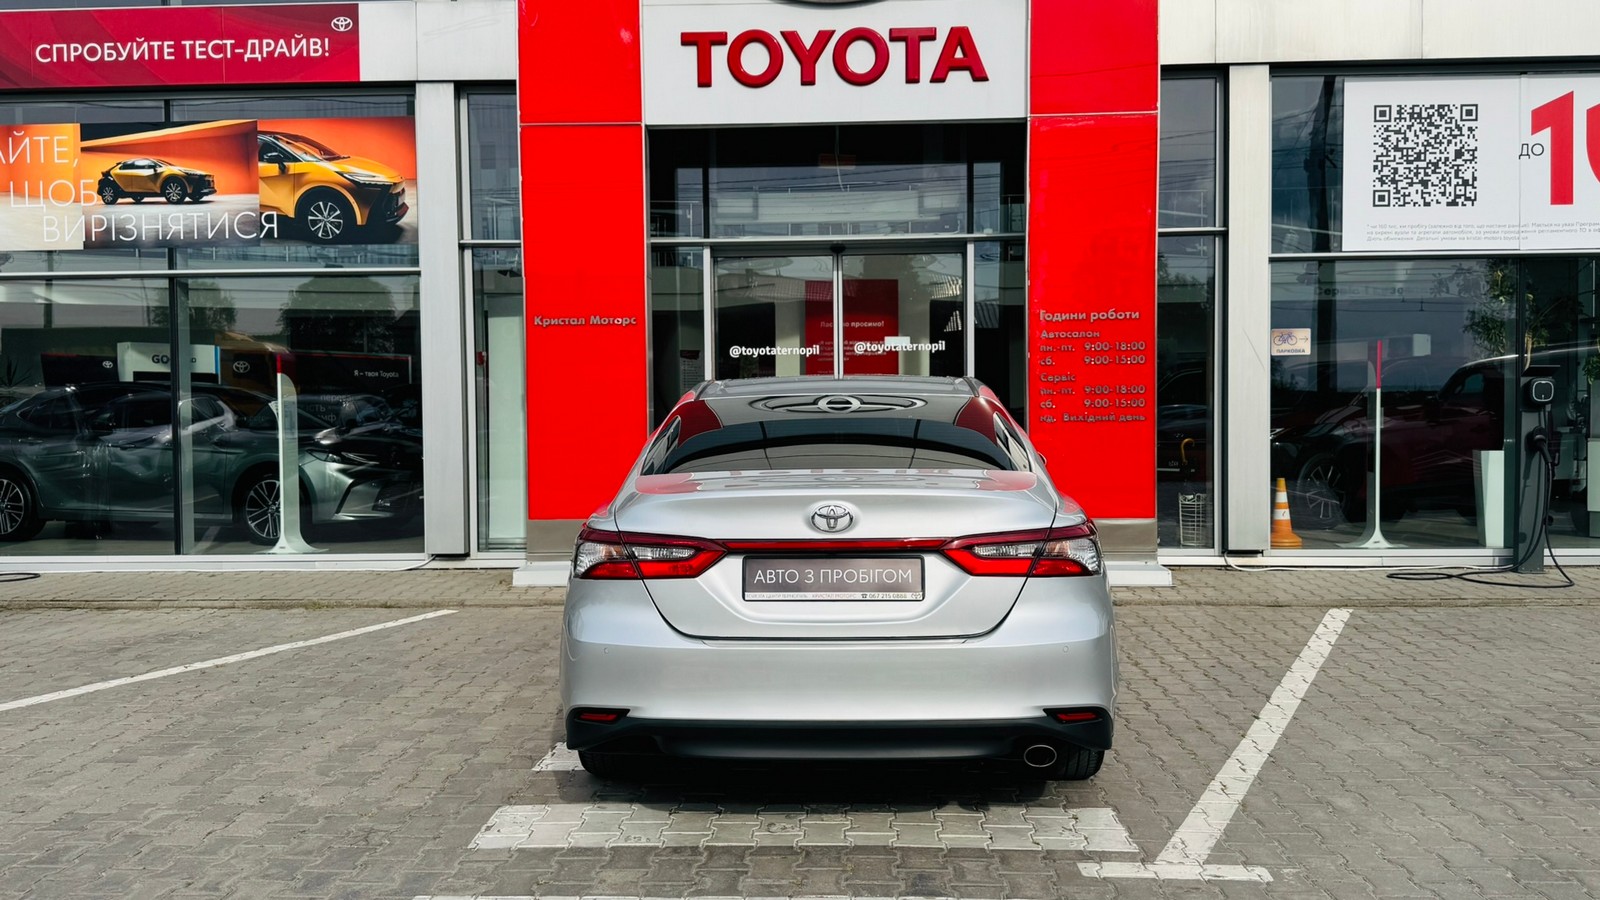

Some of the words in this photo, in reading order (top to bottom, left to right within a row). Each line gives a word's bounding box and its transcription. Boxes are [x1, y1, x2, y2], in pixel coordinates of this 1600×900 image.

[35, 37, 175, 63] СПРОБУЙТЕ
[181, 33, 330, 62] ТЕСТ-ДРАЙВ!
[680, 25, 989, 88] TOYOTA
[1531, 90, 1600, 206] 1
[10, 179, 98, 213] ЩОБ
[43, 210, 278, 242] ВИРІЗНЯТИСЯ
[534, 316, 585, 327] Кристал
[590, 315, 636, 326] Моторс
[1040, 310, 1086, 322] Години
[1090, 308, 1140, 322] роботи
[850, 319, 885, 330] просимо!
[1040, 330, 1100, 338] Автосалон
[729, 344, 820, 359] @toyotaternopil
[854, 340, 946, 355] @toyotaternopil
[1040, 371, 1076, 383] Сервіс
[1063, 411, 1116, 422] Вихідний
[1119, 414, 1146, 422] день
[754, 569, 799, 584] АВТО
[804, 569, 815, 584] З
[820, 569, 912, 584] ПРОБІГОМ
